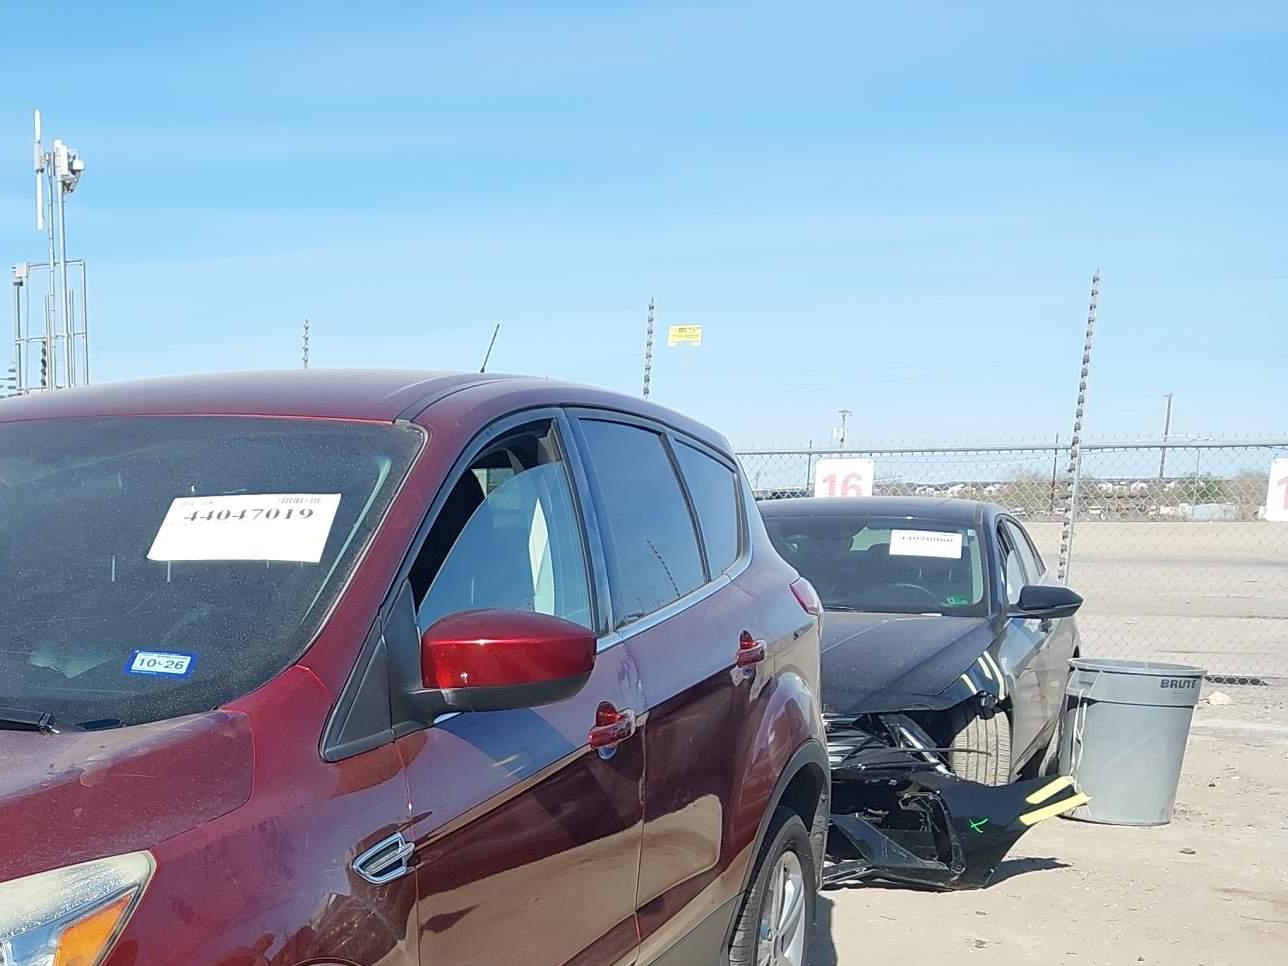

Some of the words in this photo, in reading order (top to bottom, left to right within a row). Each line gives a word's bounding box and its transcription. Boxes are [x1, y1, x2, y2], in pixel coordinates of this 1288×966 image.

[822, 473, 863, 496] 16
[184, 508, 314, 521] 44047019
[1160, 679, 1197, 689] BRUTE
